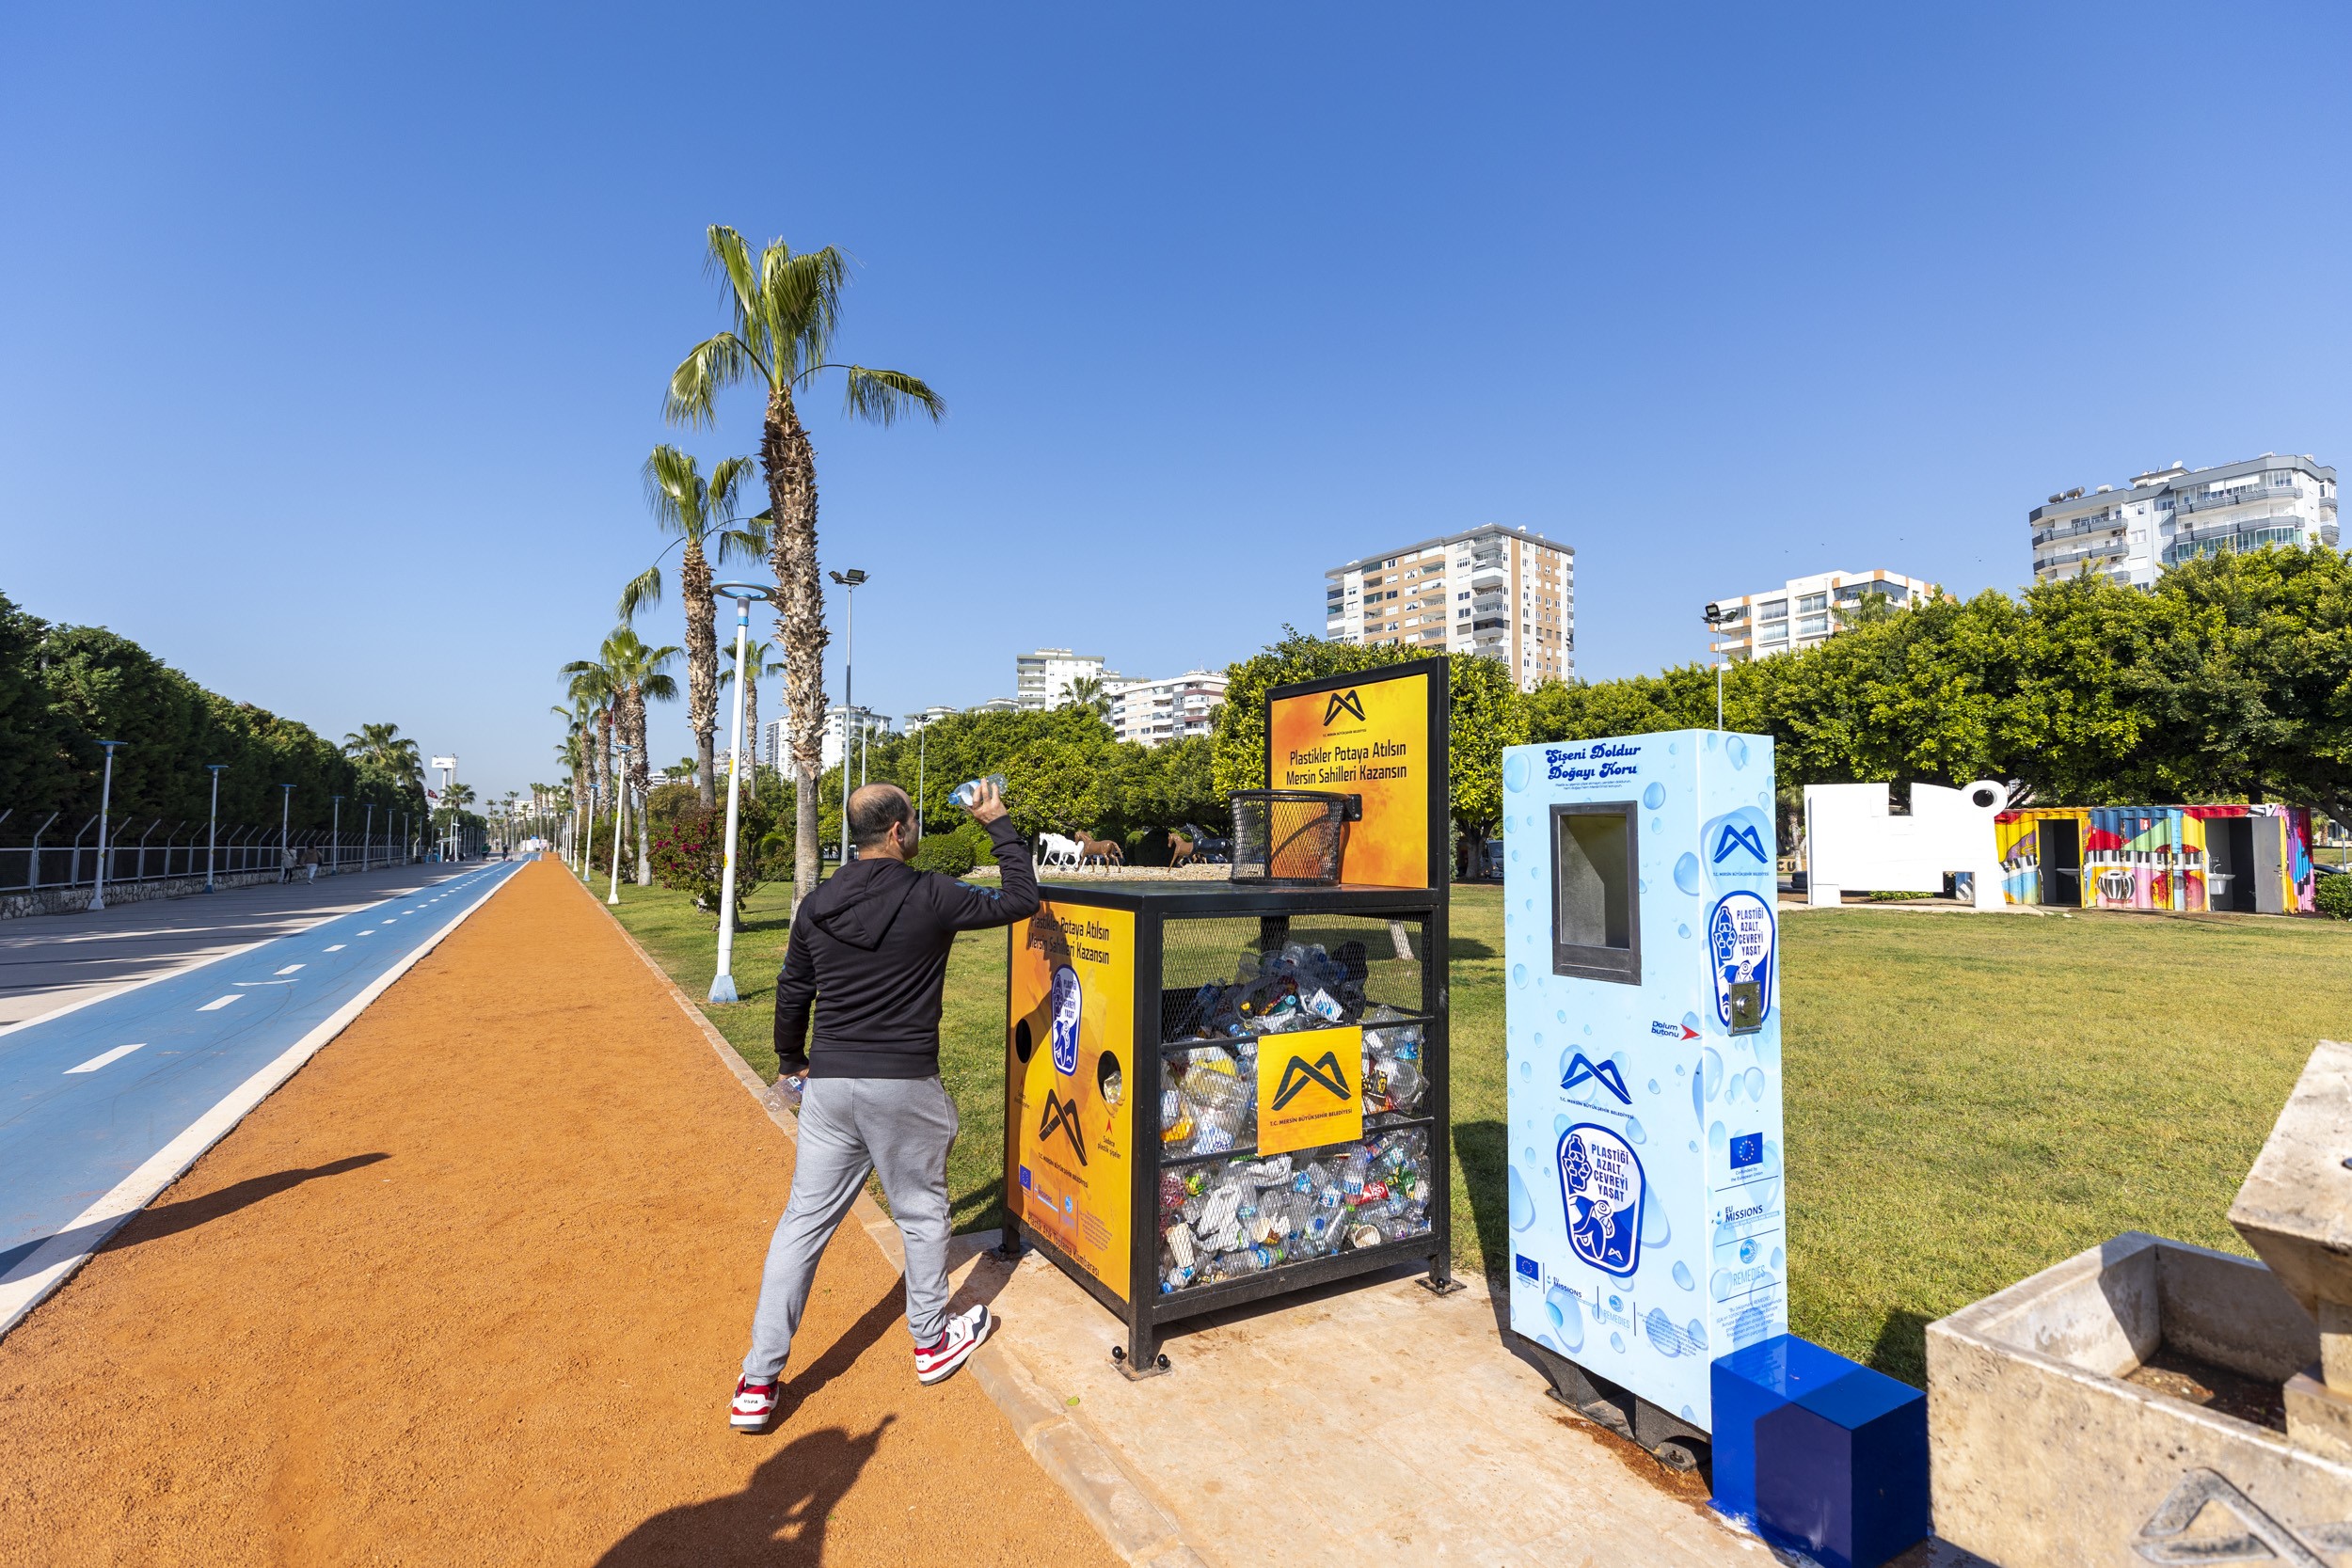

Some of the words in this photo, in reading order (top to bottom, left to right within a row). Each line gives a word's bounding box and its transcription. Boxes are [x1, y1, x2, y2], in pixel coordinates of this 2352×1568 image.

[1290, 747, 1331, 766] Plastikler
[1335, 746, 1369, 764] Potaya
[1373, 739, 1406, 758] Atılsın
[1546, 749, 1586, 767] Şişeni
[1590, 743, 1642, 759] Doldur
[1286, 770, 1316, 786] Mersin
[1319, 766, 1357, 784] Sahilleri
[1359, 765, 1407, 781] Kazansın
[1548, 765, 1596, 782] Doğayı
[1598, 762, 1637, 779] Koru
[1060, 917, 1084, 940] Potaya
[1086, 921, 1109, 941] Atılsın
[1028, 932, 1047, 951] Mersin
[1076, 942, 1109, 965] Kazansın
[1651, 1027, 1679, 1037] butonu
[1652, 1021, 1678, 1031] Dolum
[1298, 1112, 1327, 1122] BÜYÜKŞEHİR
[1328, 1107, 1353, 1117] BELEDİYESİ
[1591, 1143, 1629, 1165] PLASTİĞİ
[1725, 1205, 1763, 1223] MISSIONS
[1733, 1264, 1766, 1286] REMEDIES
[1553, 1281, 1582, 1298] MISSIONS
[1603, 1309, 1630, 1328] REMEDIES
